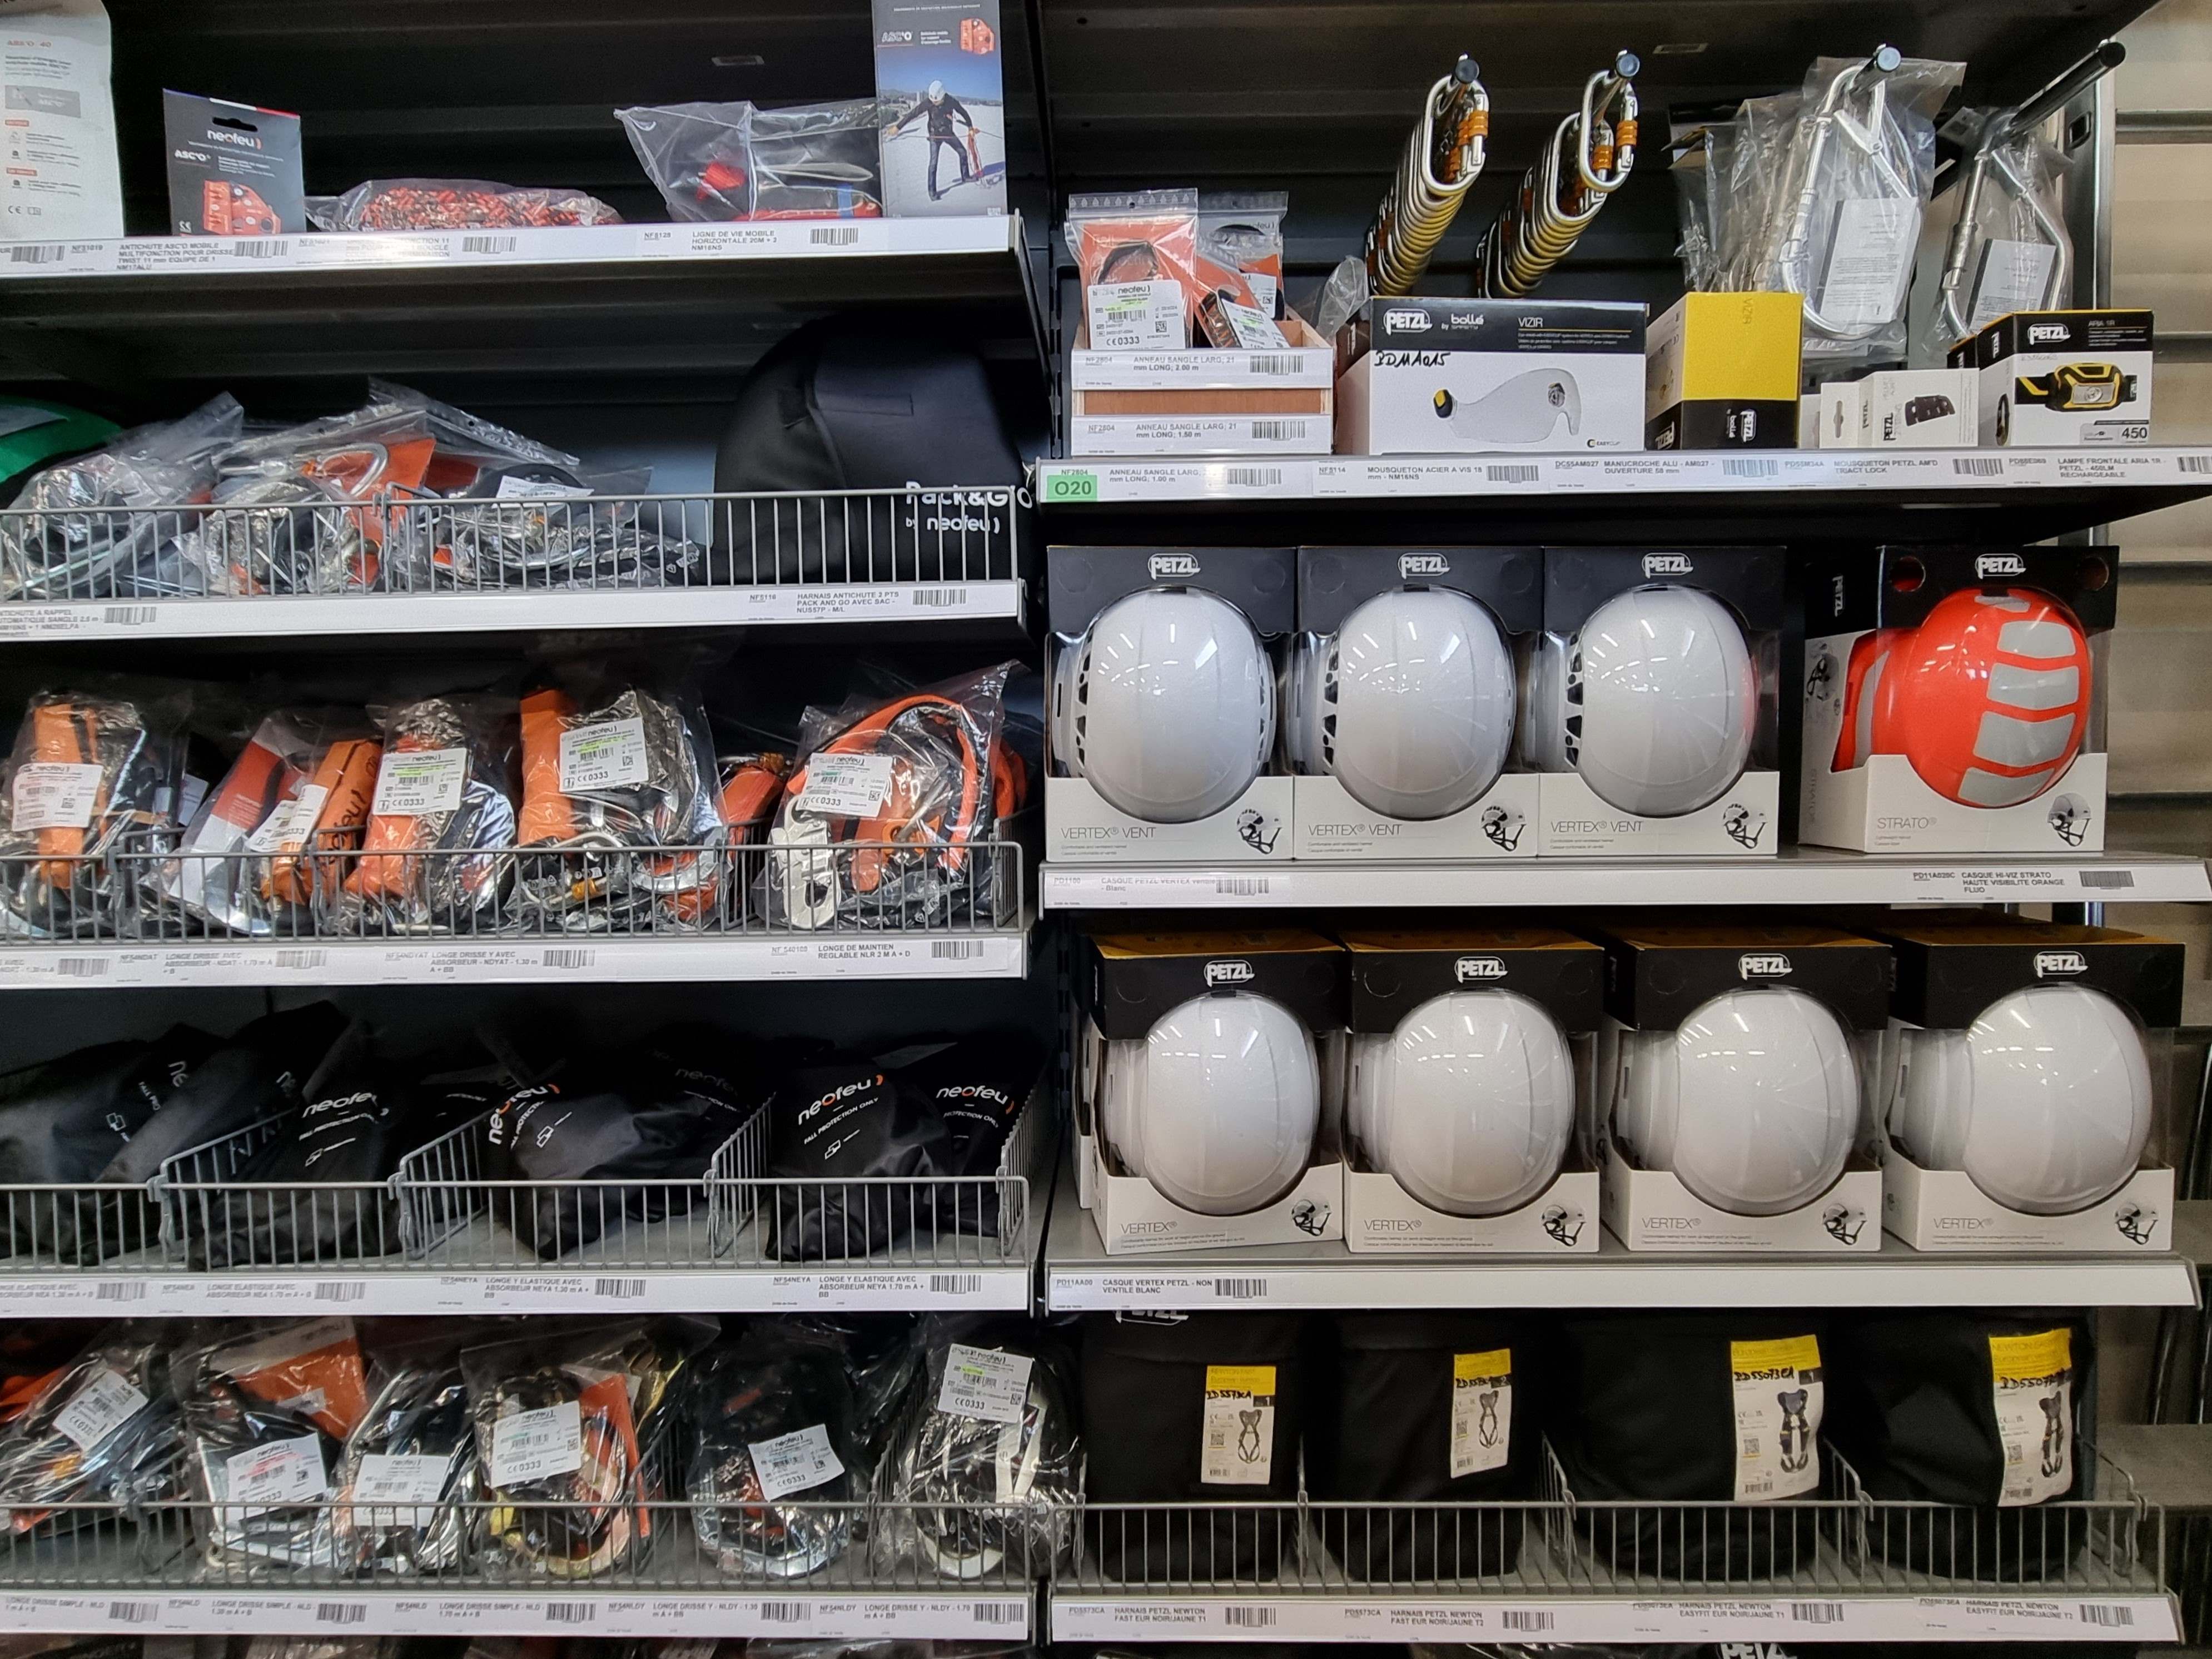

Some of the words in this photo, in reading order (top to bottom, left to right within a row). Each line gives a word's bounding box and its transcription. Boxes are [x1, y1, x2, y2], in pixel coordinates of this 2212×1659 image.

[206, 130, 255, 147] neofeu
[1117, 285, 1146, 295] neofeu
[1742, 297, 1753, 325] VIZIR
[1386, 312, 1433, 336] PETZL
[1518, 317, 1543, 328] VIZIR
[2029, 326, 2071, 345] PETZL
[1741, 409, 1756, 443] PETZL
[1883, 412, 1896, 441] PETZL
[2121, 427, 2148, 439] 450
[1151, 557, 1201, 580] PETZL
[1401, 557, 1450, 579] PETZL
[1644, 557, 1694, 579] PETZL
[1977, 558, 2026, 580] PETZL
[1122, 826, 1157, 838] VENT
[1369, 823, 1403, 836] VENT
[1610, 821, 1644, 833] VENT
[1207, 962, 1255, 987] PETZL
[1458, 960, 1508, 984] PETZL
[1741, 957, 1793, 981] PETZL
[2036, 955, 2089, 978] PETZL
[798, 1078, 872, 1126] neofeu
[936, 1085, 1008, 1105] neofeu
[804, 1131, 817, 1145] FALL
[818, 1106, 858, 1135] PROTECTION
[859, 1097, 879, 1109] ONLY
